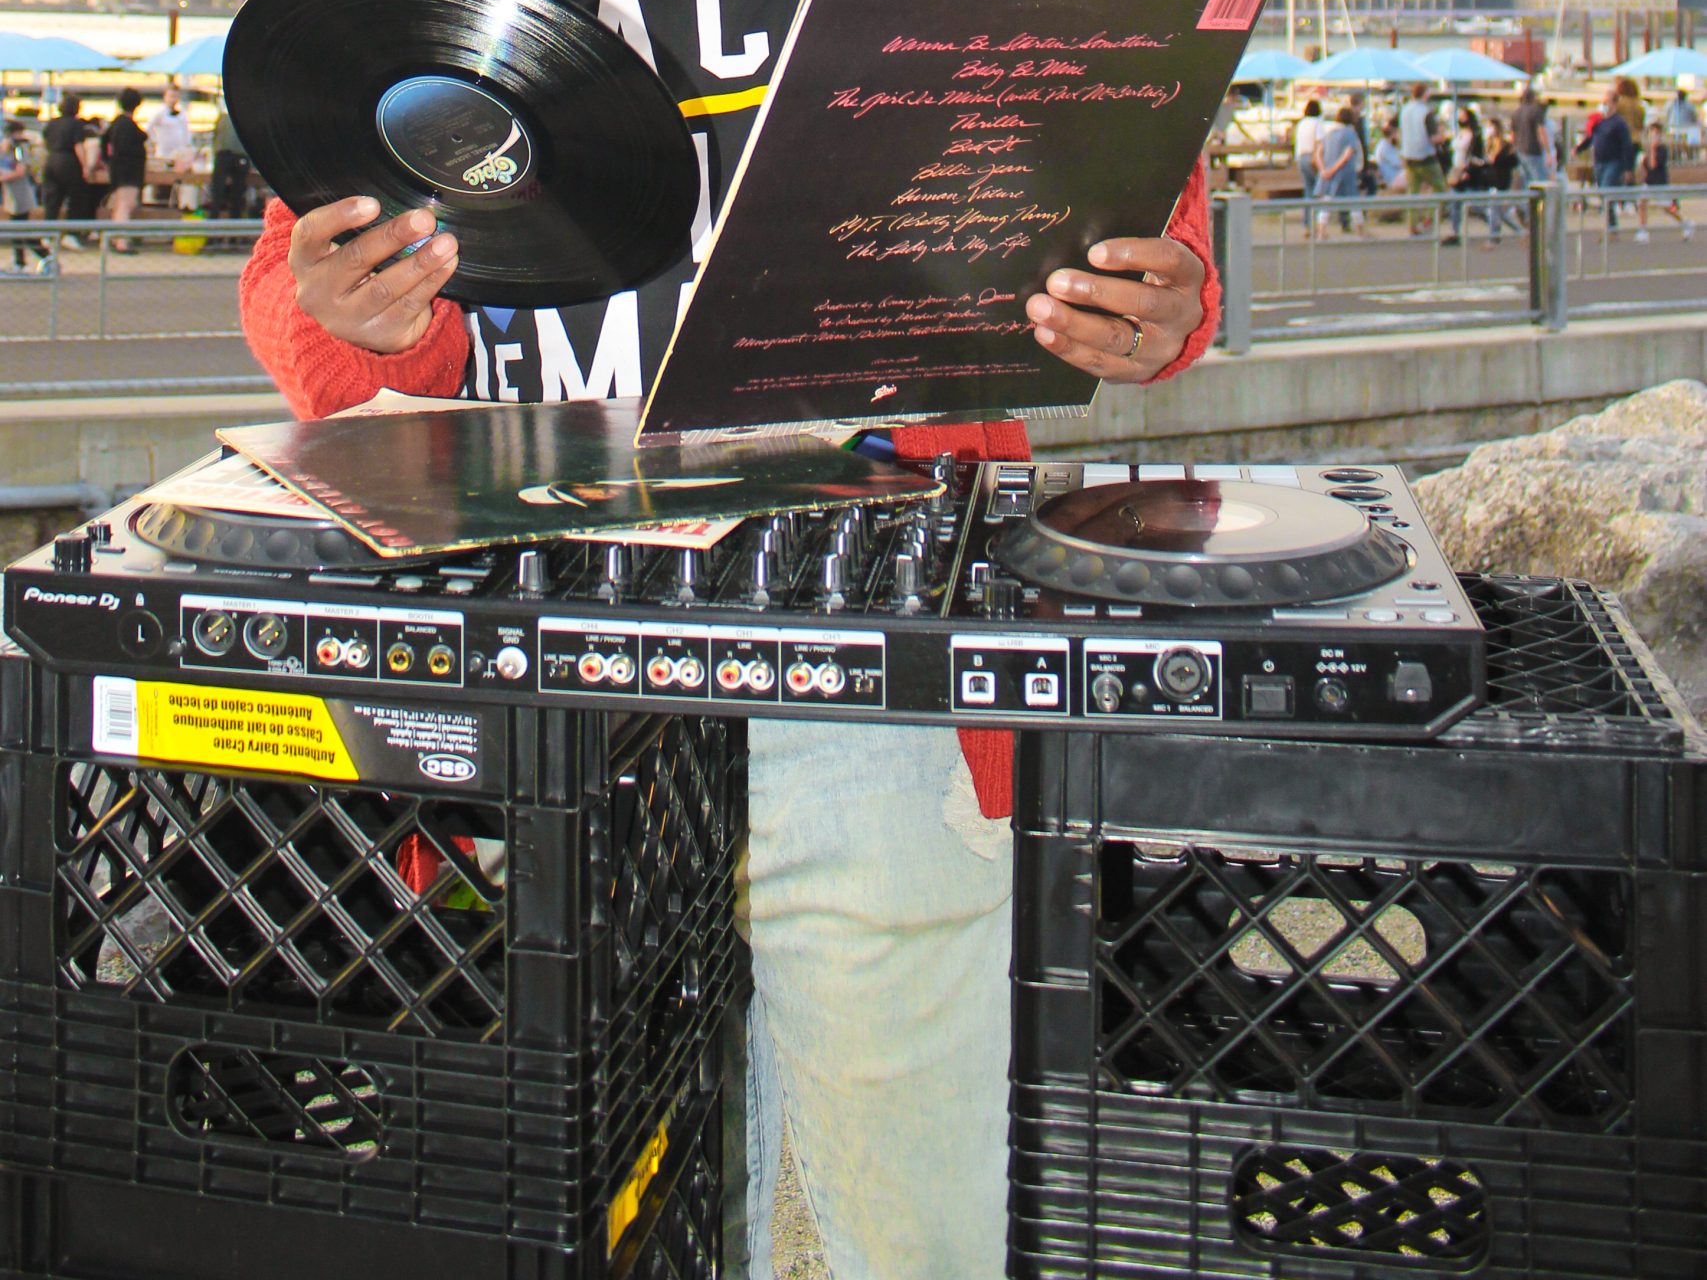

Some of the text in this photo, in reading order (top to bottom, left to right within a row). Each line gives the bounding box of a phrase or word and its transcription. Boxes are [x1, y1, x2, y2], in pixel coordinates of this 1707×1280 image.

[882, 36, 962, 53] Wanna
[962, 36, 990, 52] Be
[952, 59, 1087, 89] Baby Be Mine
[827, 87, 860, 108] The
[854, 89, 912, 119] Girl
[907, 90, 935, 106] Is
[938, 89, 995, 106] Mine
[950, 113, 1044, 131] Thriller
[943, 135, 1032, 156] Beat It
[462, 155, 518, 190] Epic
[911, 163, 1034, 189] Billie Jean
[891, 186, 1025, 205] Human Nature
[953, 208, 1009, 233] Young
[847, 232, 1031, 263] The Lady In My Life
[23, 586, 97, 606] Pioneer
[223, 600, 251, 609] MASTER
[325, 607, 352, 615] MASTER
[408, 612, 433, 621] BOOTH
[405, 625, 437, 634] BALANCED
[497, 627, 525, 637] SIGNAL
[503, 636, 520, 644] GND
[586, 635, 600, 643] LINE
[604, 636, 626, 644] PHONO
[737, 642, 752, 650] LINE
[794, 644, 808, 652] LINE
[813, 646, 836, 654] PHONO
[1145, 642, 1160, 650] MIC
[1099, 654, 1111, 662] MIC
[1320, 649, 1344, 659] DC IN
[973, 655, 983, 667] B
[1037, 657, 1047, 669] A
[1090, 663, 1126, 672] BALANCED
[1351, 664, 1367, 673] 12V
[168, 694, 313, 721] Auténtico cajón de leche
[1153, 704, 1165, 712] MIC
[1178, 705, 1213, 713] BALANCED
[172, 713, 323, 742] Caisse de lait authentique
[213, 737, 336, 764] Authentic Dairy Crate
[426, 759, 470, 776] GSC
